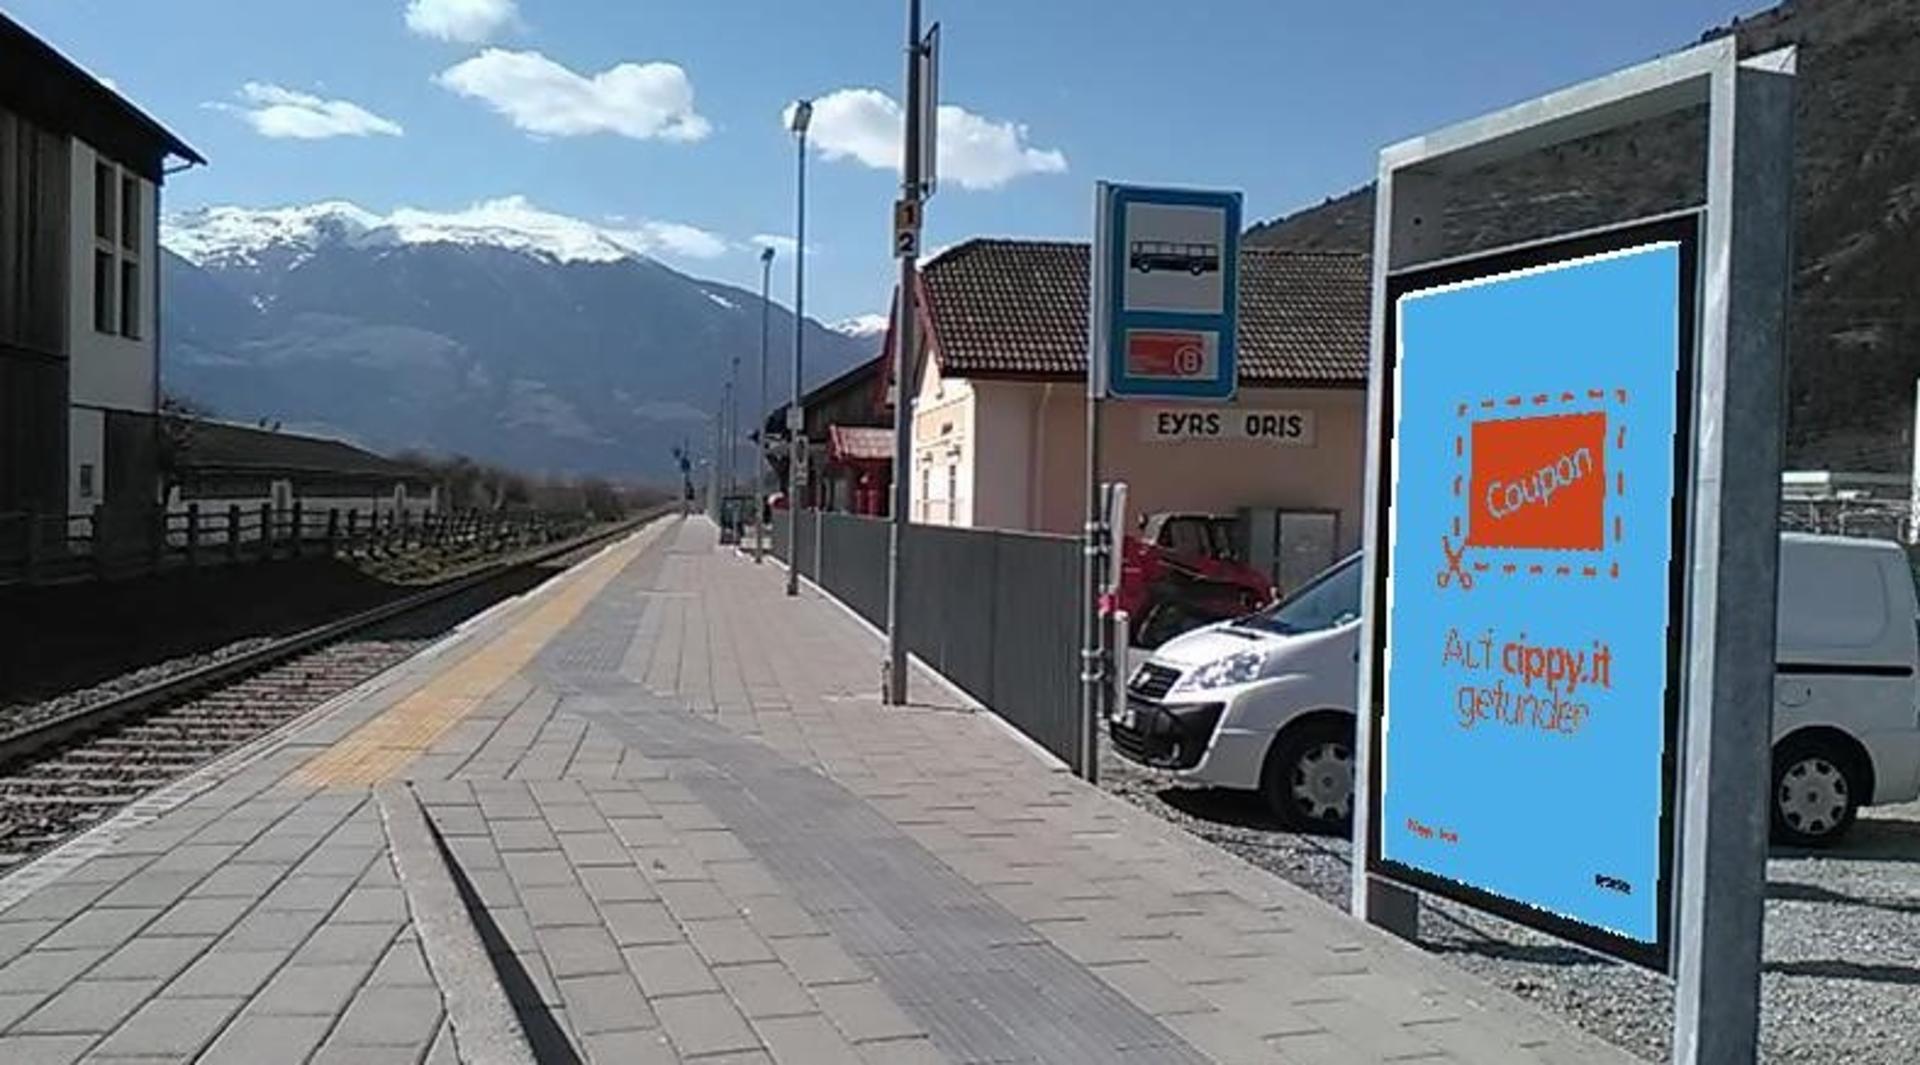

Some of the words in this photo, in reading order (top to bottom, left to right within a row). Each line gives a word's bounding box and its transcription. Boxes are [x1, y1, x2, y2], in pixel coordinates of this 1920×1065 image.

[904, 203, 915, 224] 1
[899, 231, 915, 252] 2
[1157, 412, 1221, 435] EYRS
[1245, 414, 1303, 438] ORIS
[1485, 447, 1593, 520] Coupon
[1502, 631, 1612, 694] cippy.it
